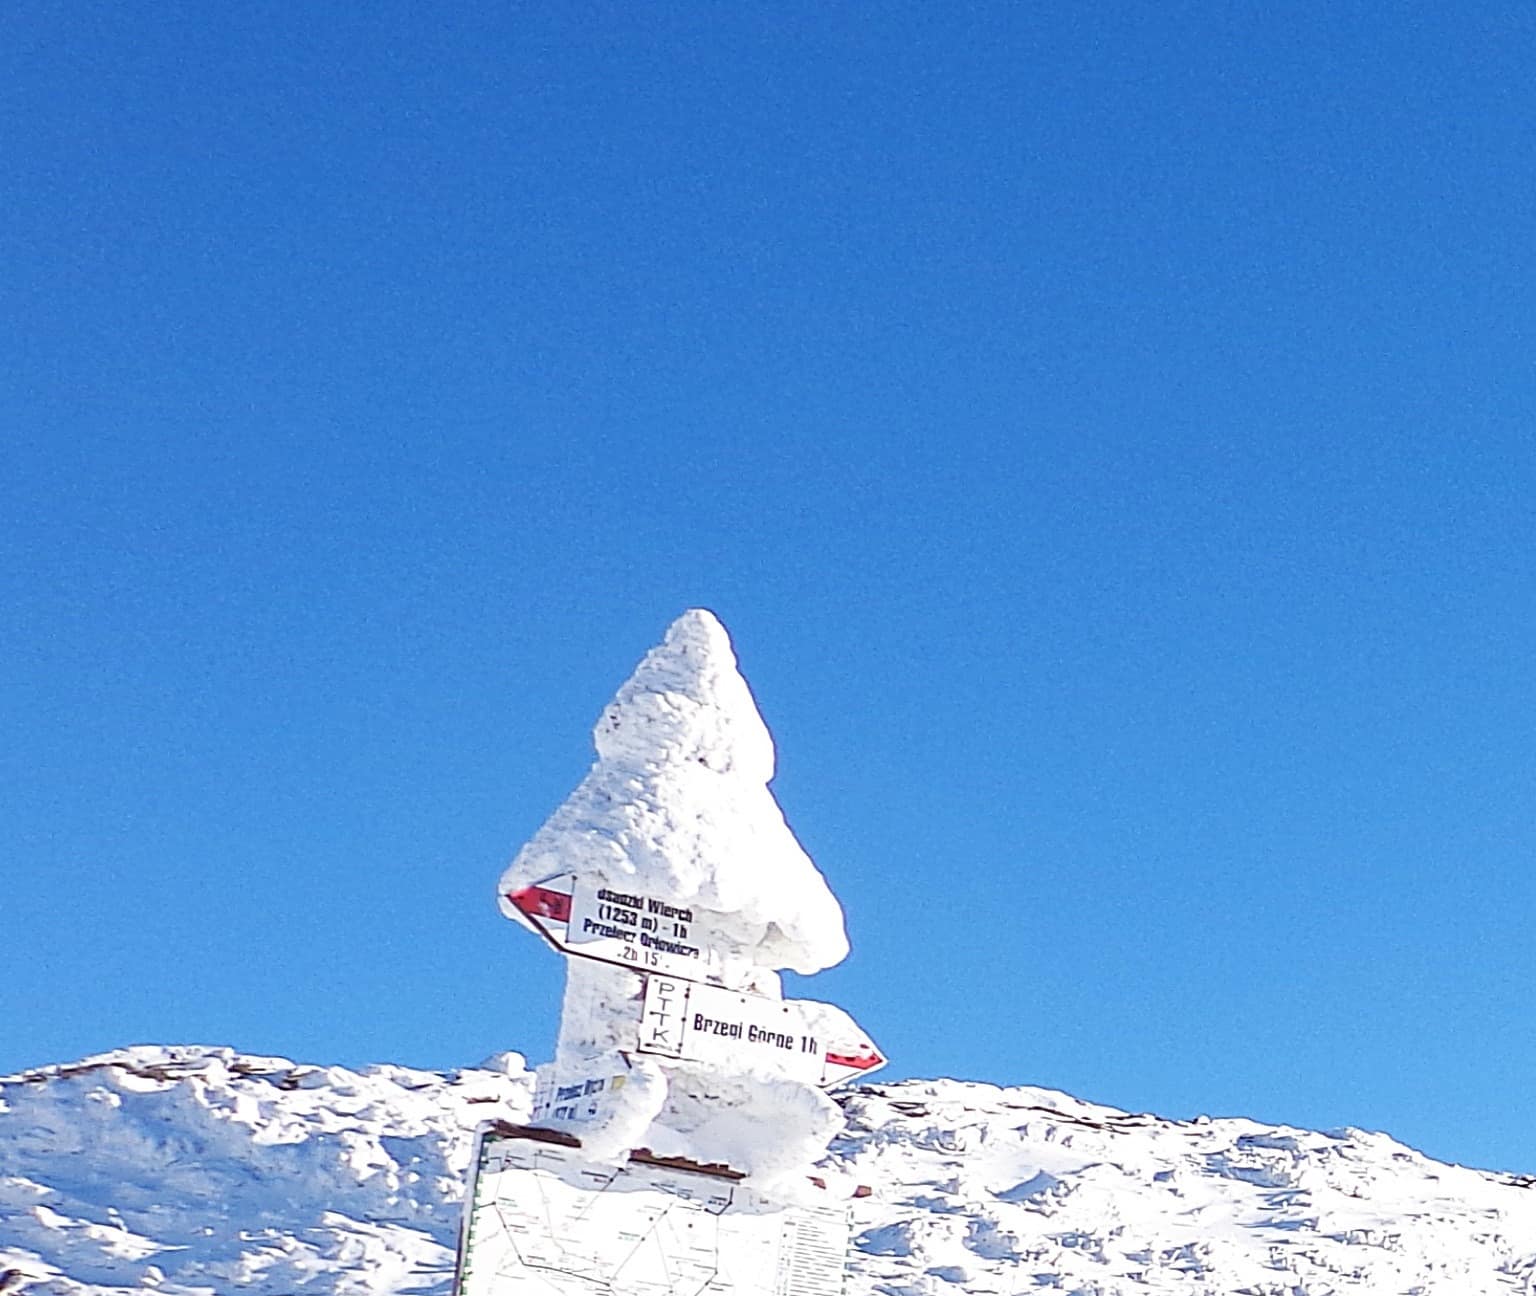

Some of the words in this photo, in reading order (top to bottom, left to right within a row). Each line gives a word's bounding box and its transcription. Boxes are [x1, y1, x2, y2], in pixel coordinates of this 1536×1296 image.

[599, 903, 638, 926] (1253
[641, 917, 658, 933] m)
[672, 922, 688, 939] 1h
[647, 898, 692, 922] Wierch
[693, 1013, 744, 1040] Brzegi
[748, 1024, 794, 1050] Górne
[801, 1035, 818, 1055] 1h
